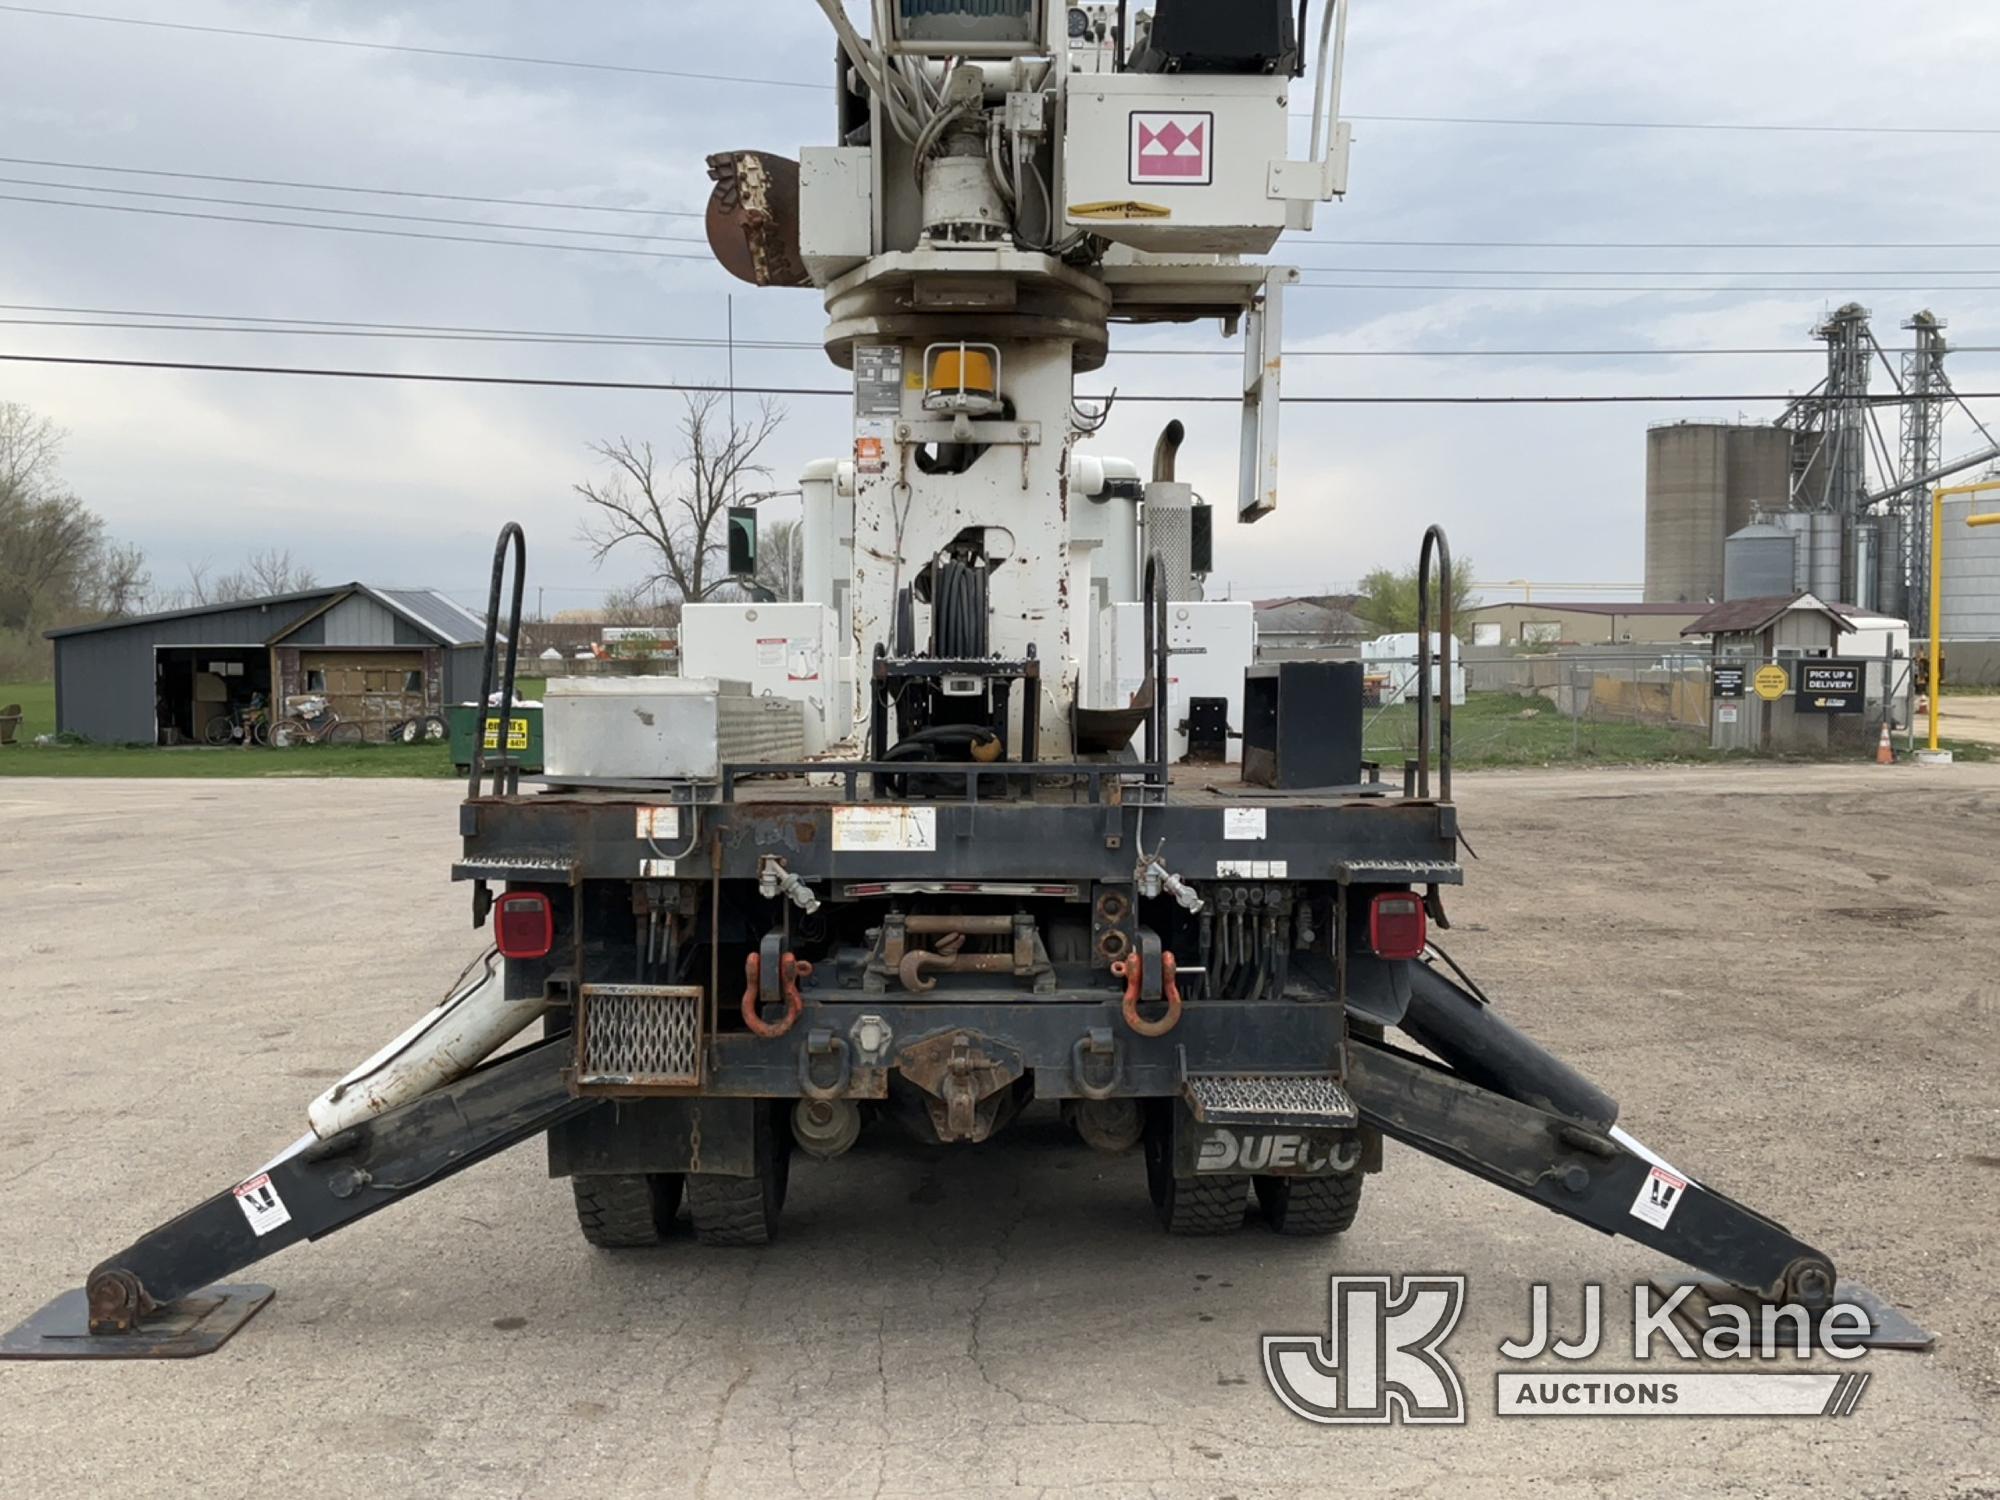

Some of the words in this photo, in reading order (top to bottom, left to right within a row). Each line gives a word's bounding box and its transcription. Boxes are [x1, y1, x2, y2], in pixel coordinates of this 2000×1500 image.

[1809, 671, 1831, 679] PICK
[1833, 671, 1845, 679] UP
[1847, 671, 1853, 679] &
[1809, 680, 1853, 688] DELIVERY
